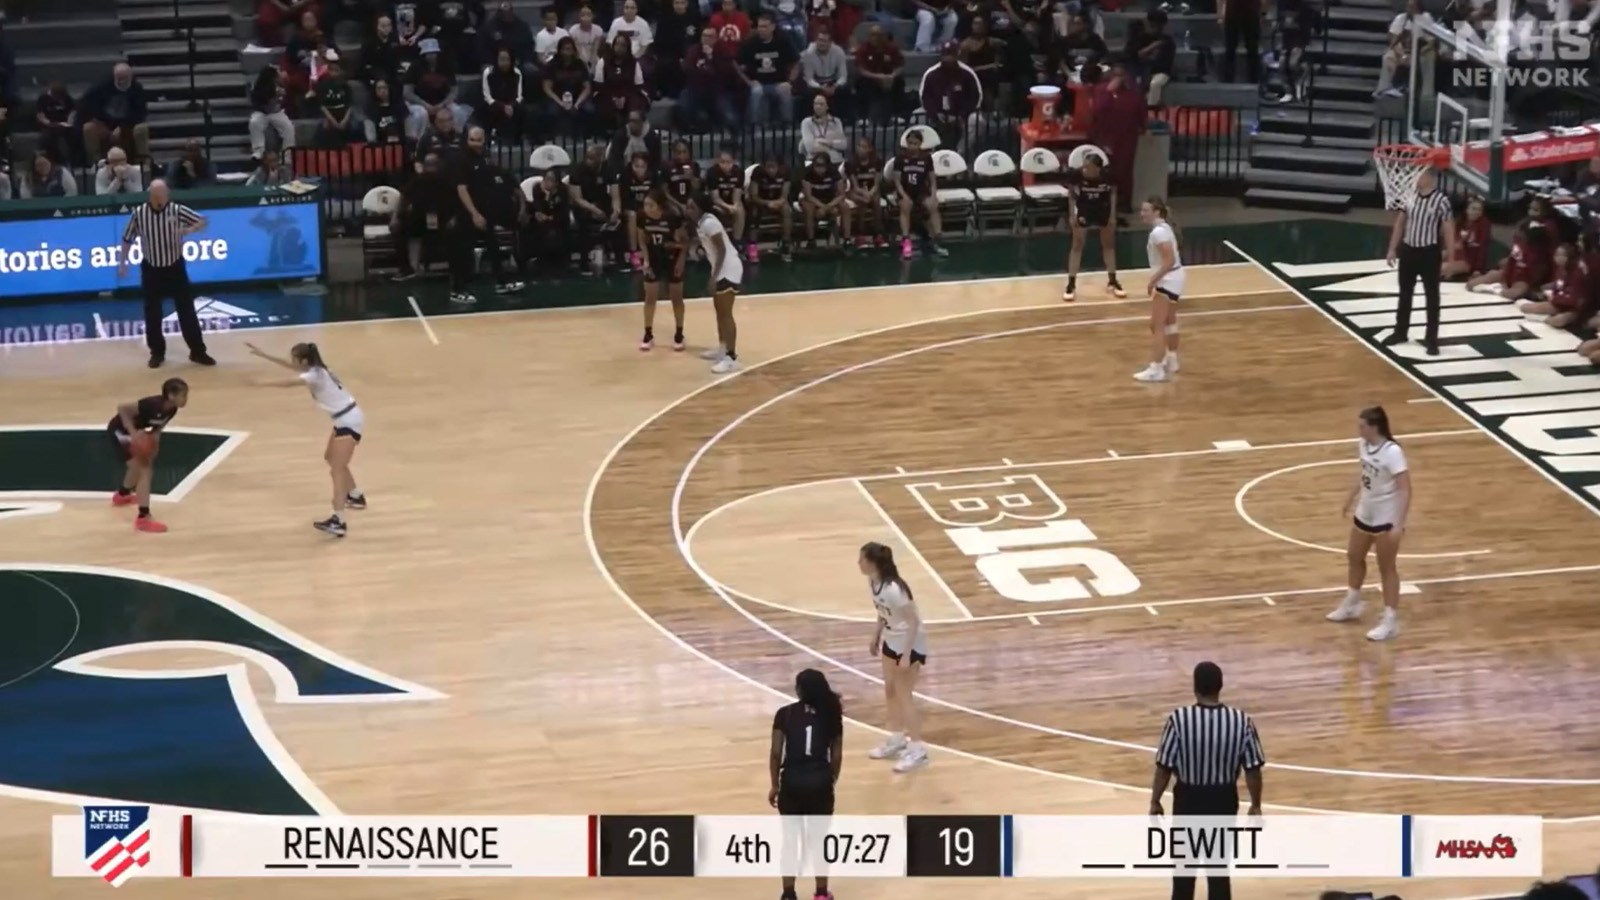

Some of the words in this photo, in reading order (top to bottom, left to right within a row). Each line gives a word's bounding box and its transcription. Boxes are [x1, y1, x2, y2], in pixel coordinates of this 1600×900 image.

[183, 237, 228, 261] ore
[651, 233, 663, 245] 17
[805, 725, 813, 756] 1
